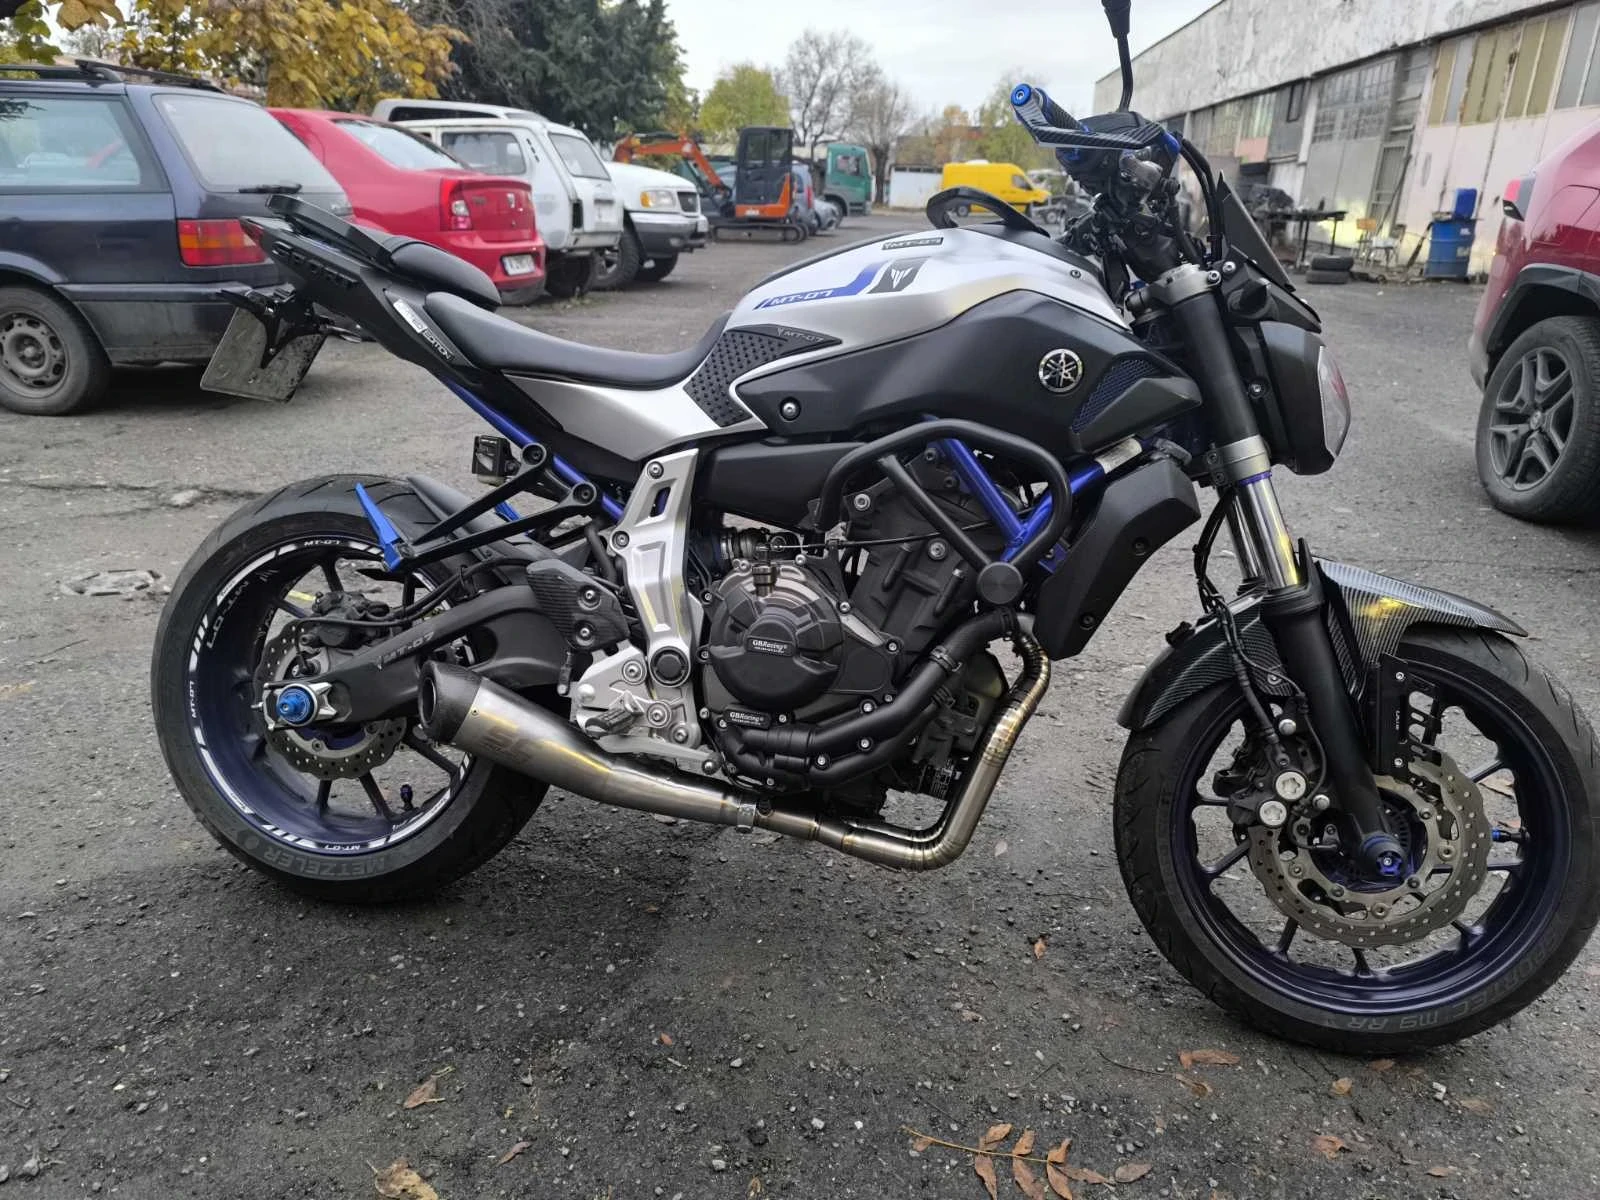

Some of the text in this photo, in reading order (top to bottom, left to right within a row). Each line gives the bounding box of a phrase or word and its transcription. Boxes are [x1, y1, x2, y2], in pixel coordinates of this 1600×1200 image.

[770, 289, 834, 305] MT-07
[783, 329, 825, 343] MT-07
[303, 539, 342, 547] MT-07
[206, 580, 250, 649] MT-07
[188, 680, 197, 719] MT-07
[262, 849, 386, 877] METZELER
[1347, 1015, 1389, 1030] RR
